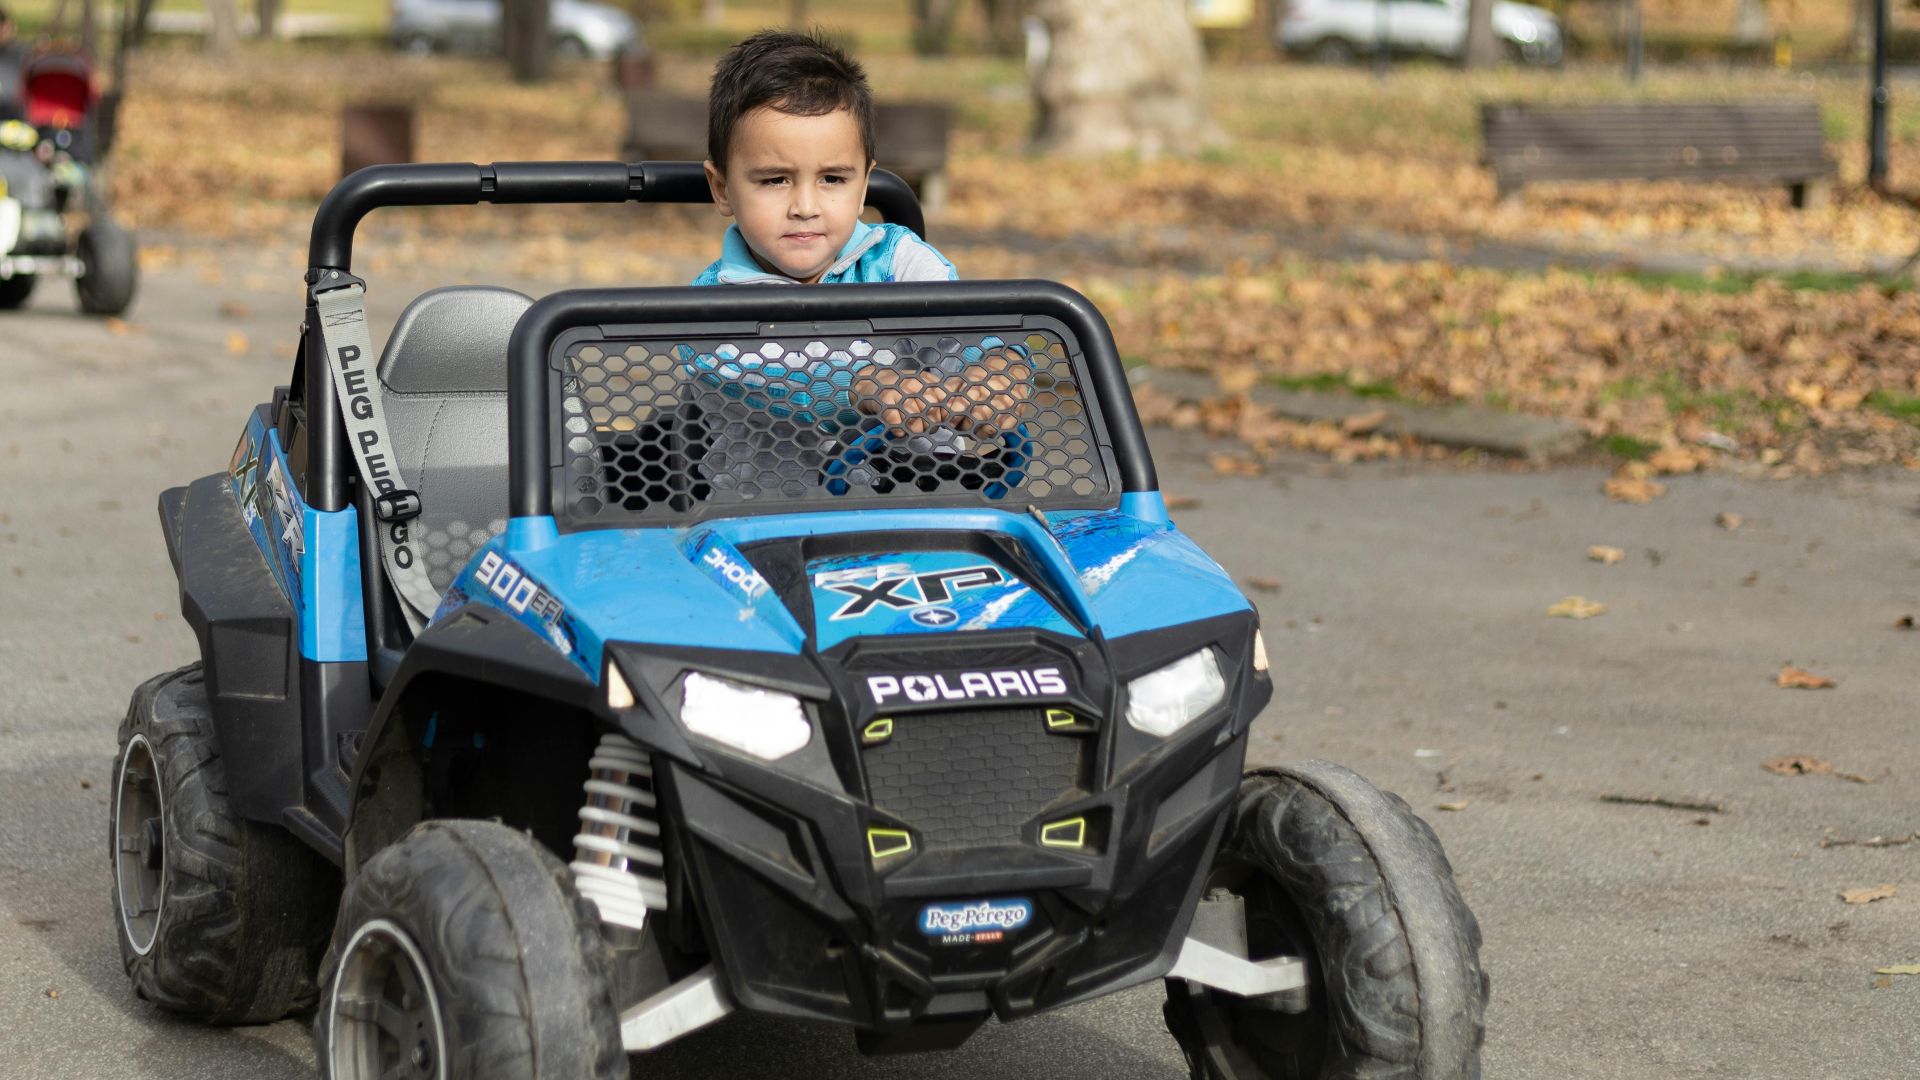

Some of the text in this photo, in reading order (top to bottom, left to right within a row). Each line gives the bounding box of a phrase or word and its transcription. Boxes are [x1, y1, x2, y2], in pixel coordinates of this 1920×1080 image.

[337, 345, 374, 420] PEG
[824, 565, 1004, 621] XP
[867, 668, 1067, 704] POLARIS
[942, 934, 971, 944] MADE
